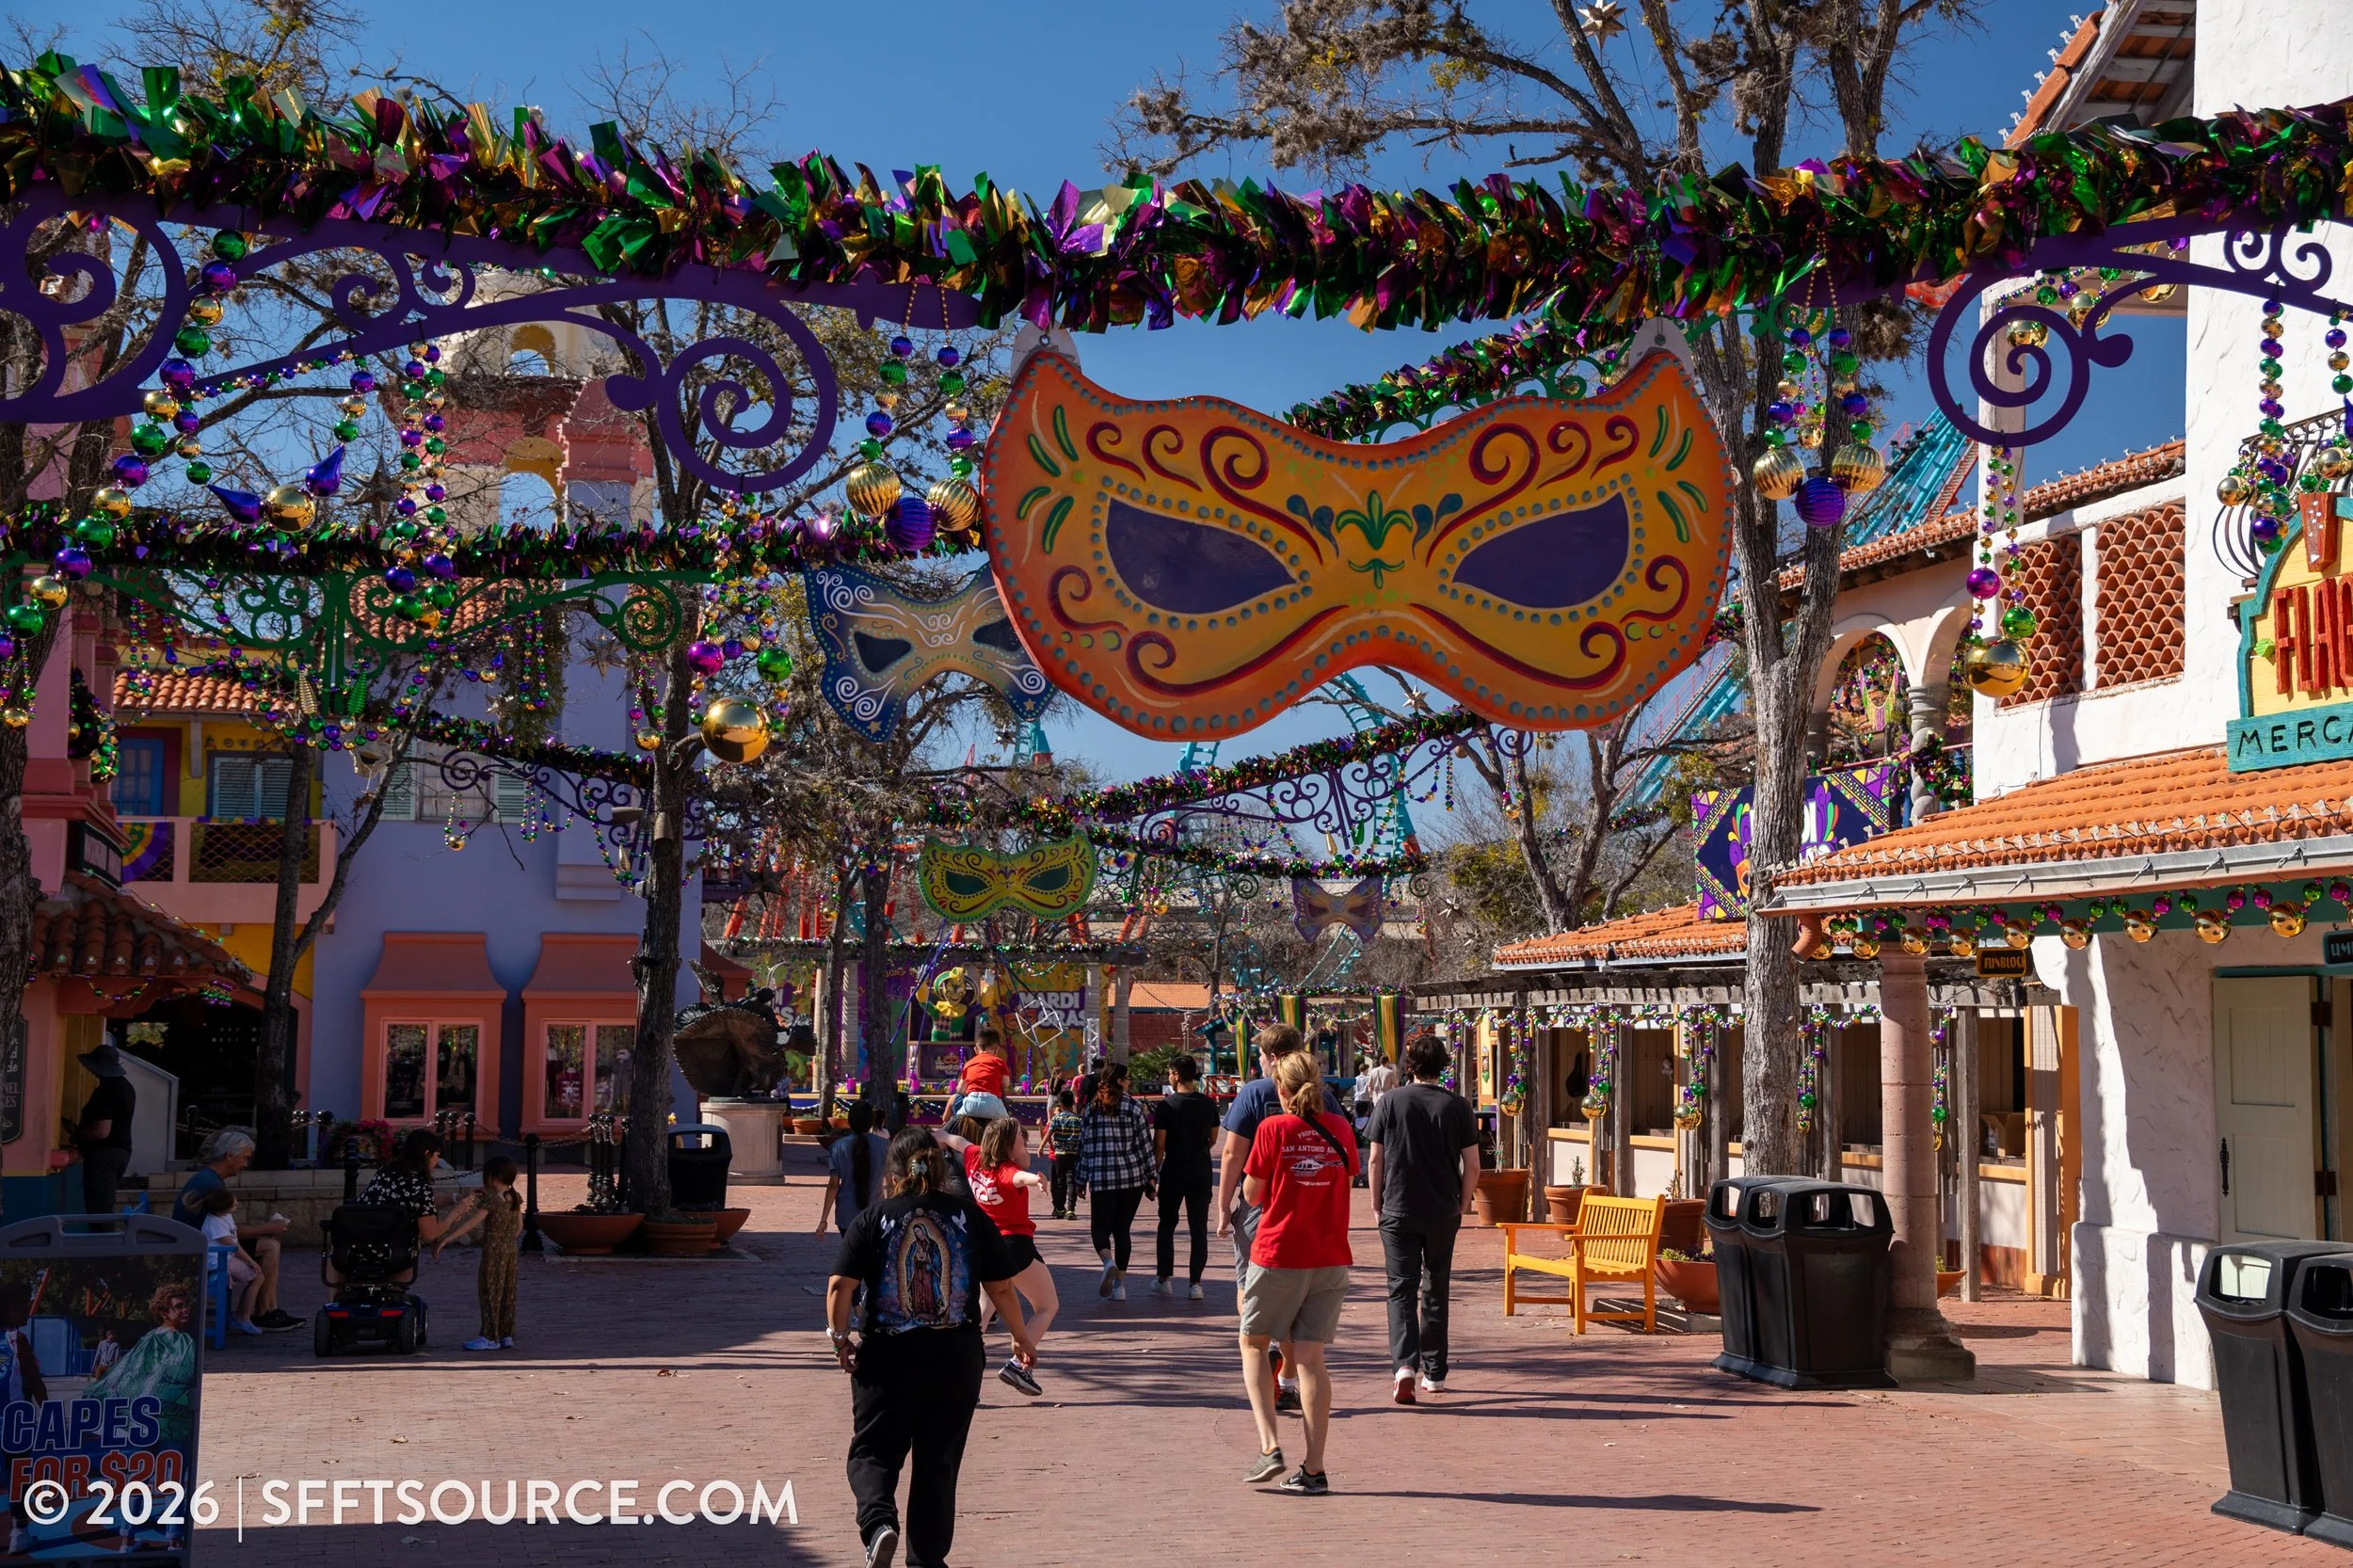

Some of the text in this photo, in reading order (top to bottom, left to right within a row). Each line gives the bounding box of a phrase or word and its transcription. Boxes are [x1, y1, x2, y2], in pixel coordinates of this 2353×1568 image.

[2237, 714, 2353, 758] MERC
[1017, 991, 1080, 1009] MARDI
[1297, 1144, 1325, 1153] ANTONIO
[1, 1396, 162, 1454] CAPES
[9, 1449, 184, 1503] FOR $20
